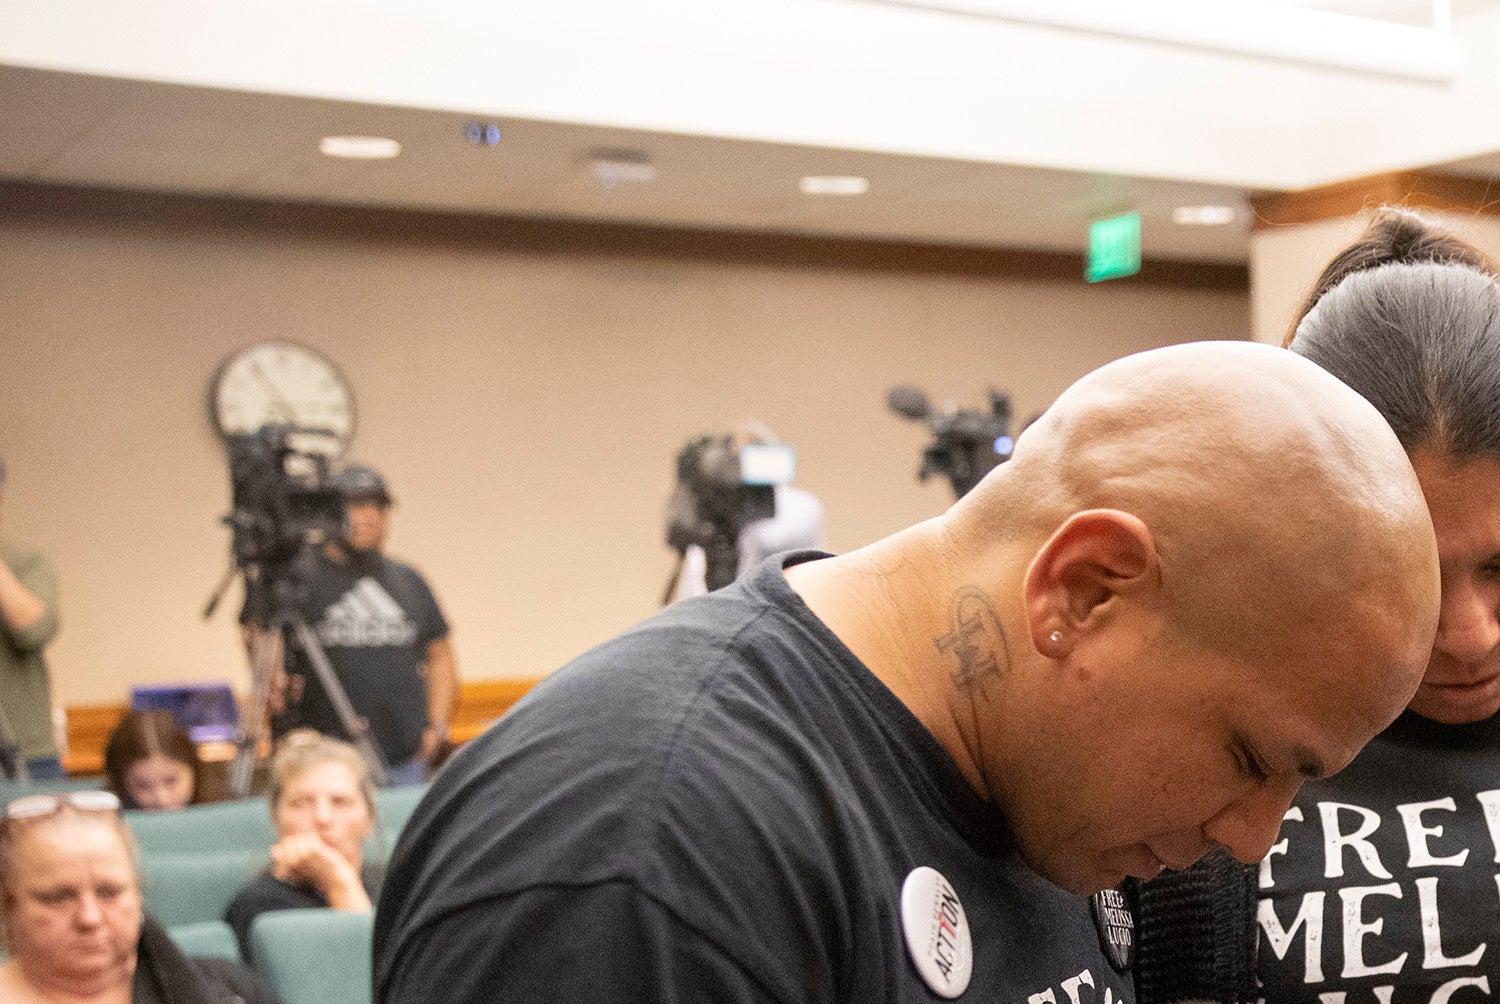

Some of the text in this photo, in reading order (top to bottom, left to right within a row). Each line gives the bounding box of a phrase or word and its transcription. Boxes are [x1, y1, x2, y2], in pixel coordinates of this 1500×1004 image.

[1101, 889, 1121, 908] FREE
[1105, 907, 1134, 928] MELISSA
[934, 884, 960, 984] ACTION
[1108, 926, 1131, 946] LUCIO
